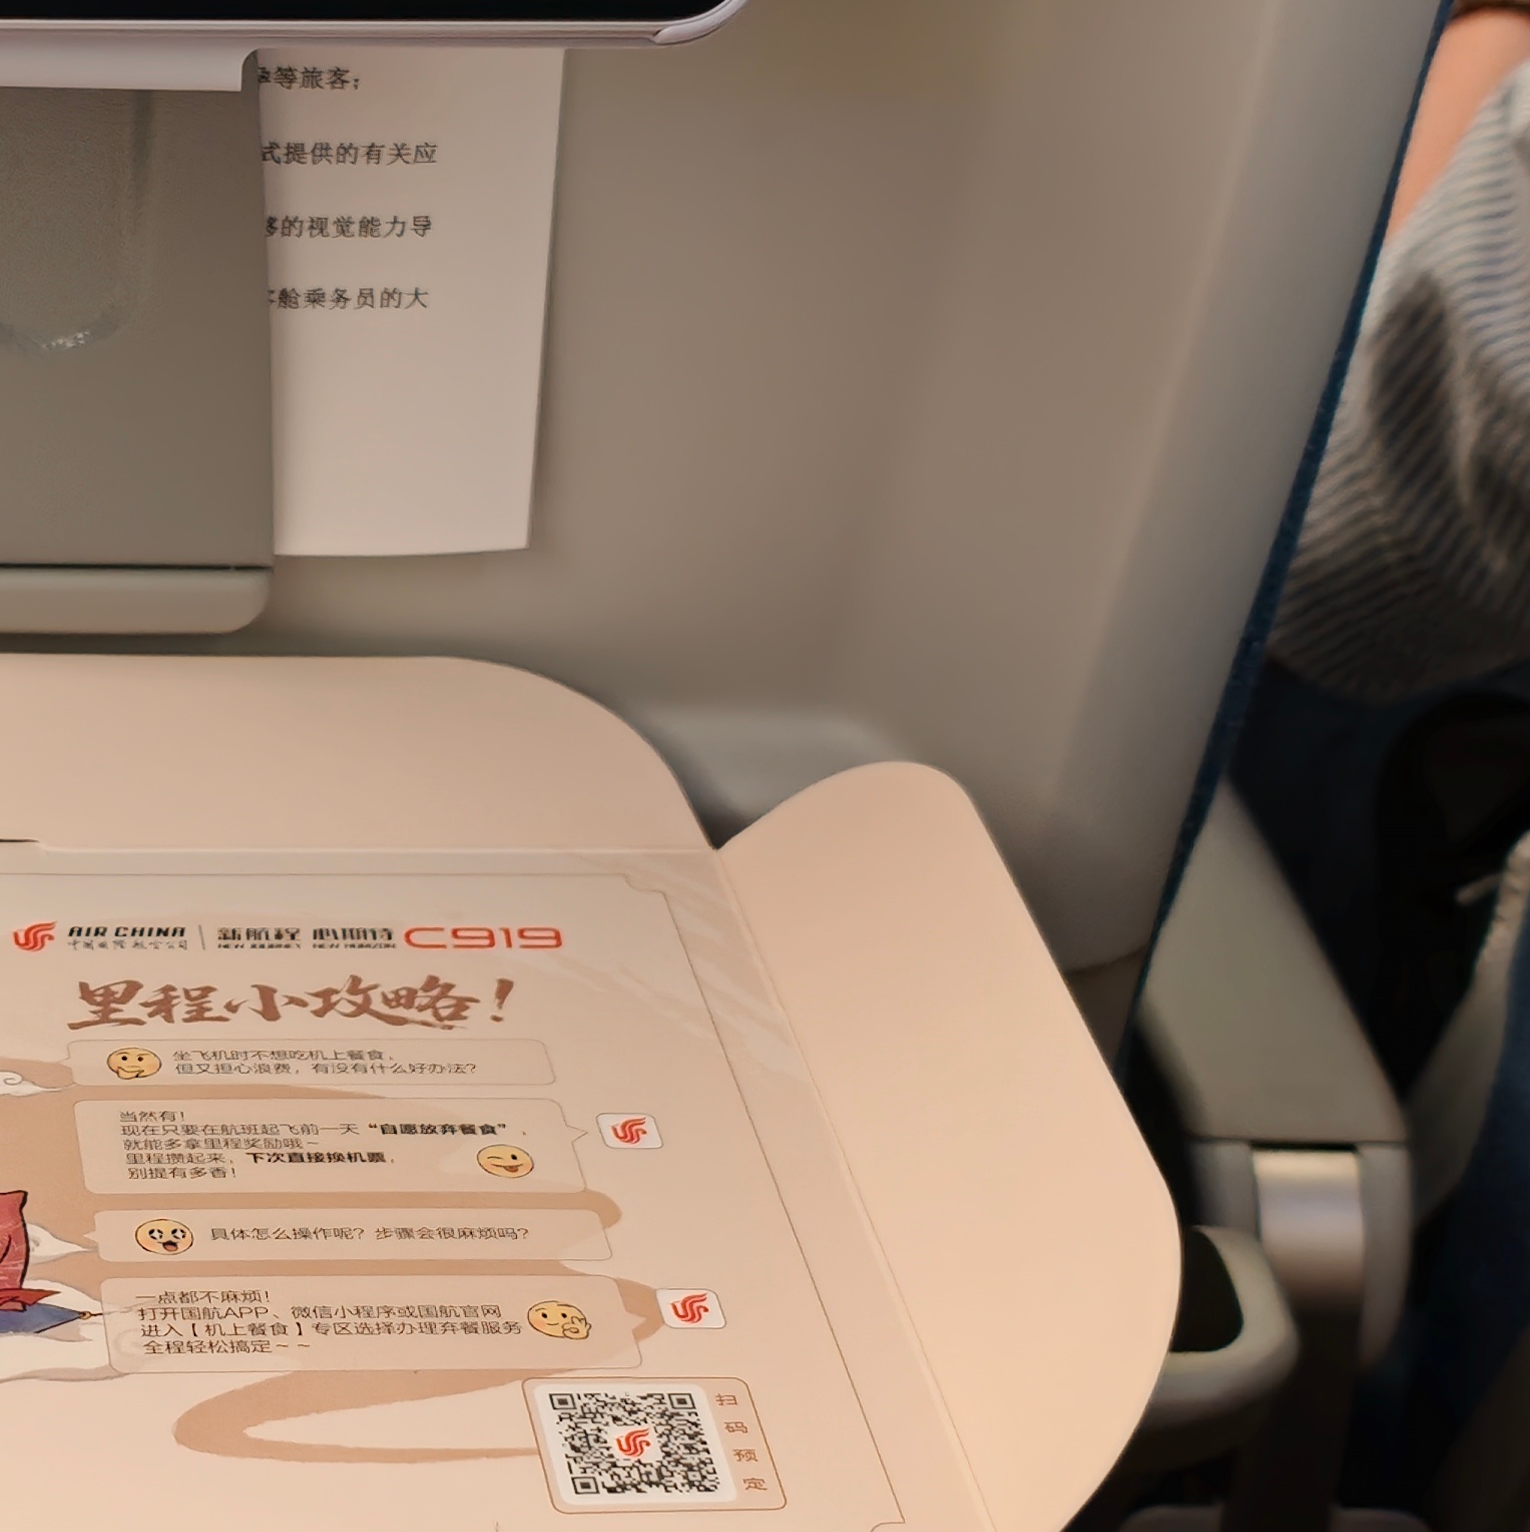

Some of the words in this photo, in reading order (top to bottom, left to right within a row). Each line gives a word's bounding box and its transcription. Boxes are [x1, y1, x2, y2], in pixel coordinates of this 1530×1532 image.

[67, 926, 108, 938] AIR
[114, 926, 187, 938] CHINA
[403, 925, 563, 950] C919
[66, 973, 515, 1031] 里程小攻略！
